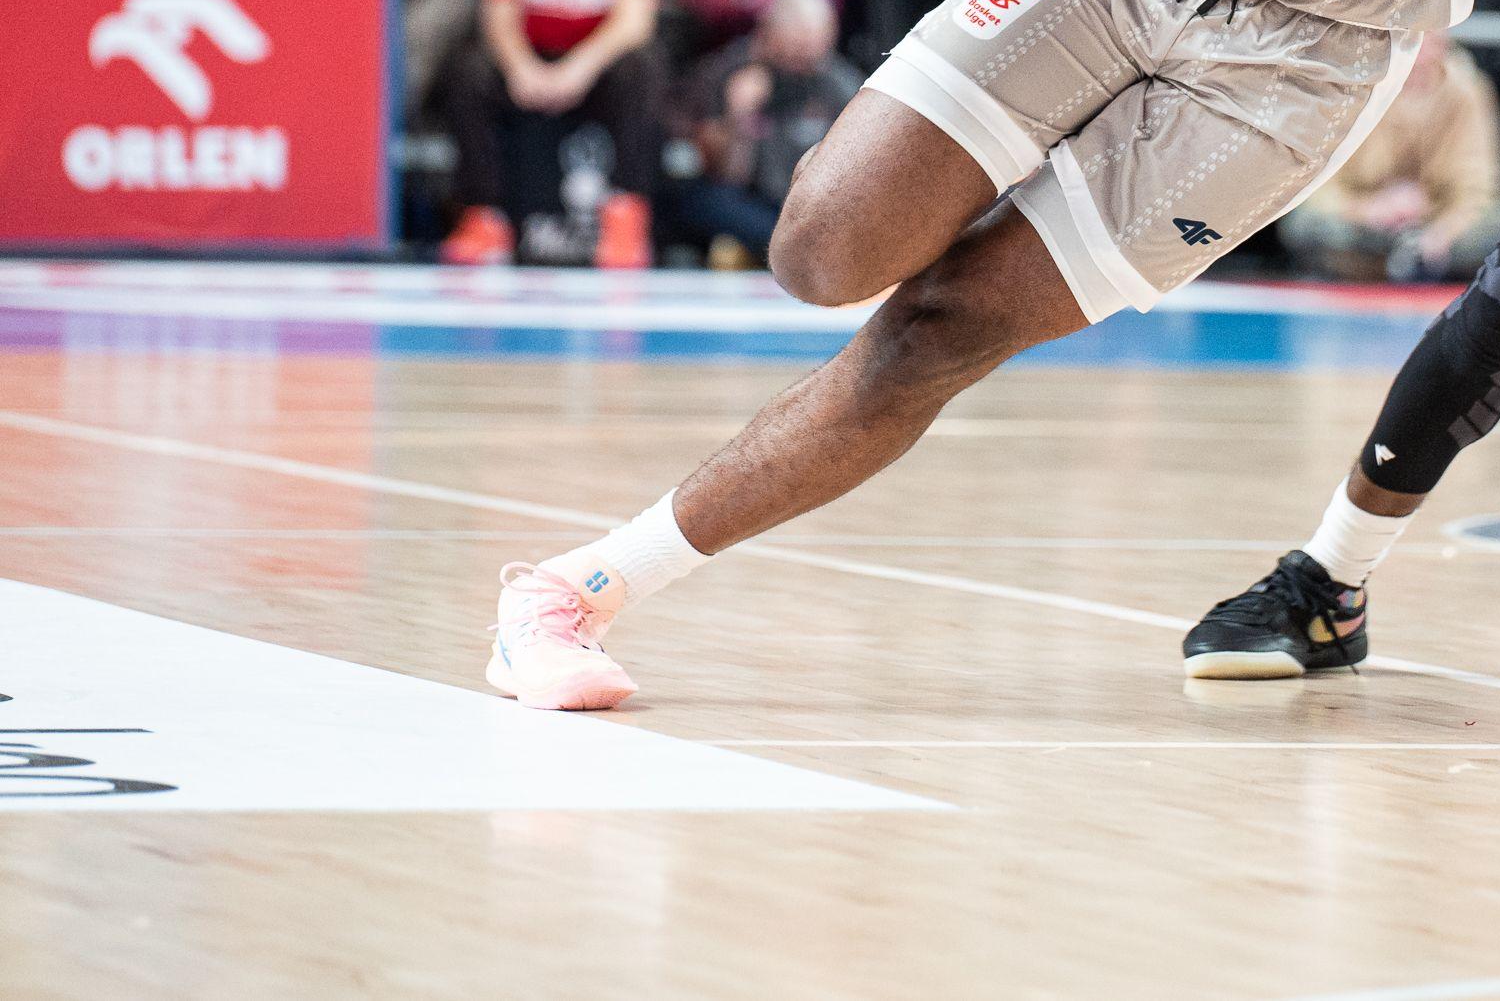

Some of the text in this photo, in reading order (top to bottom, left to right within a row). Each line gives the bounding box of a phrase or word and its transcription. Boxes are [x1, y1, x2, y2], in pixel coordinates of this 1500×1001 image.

[965, 9, 986, 27] Liga
[969, 0, 1001, 26] Basket
[63, 126, 287, 192] ORLEN
[1173, 217, 1222, 246] 4F
